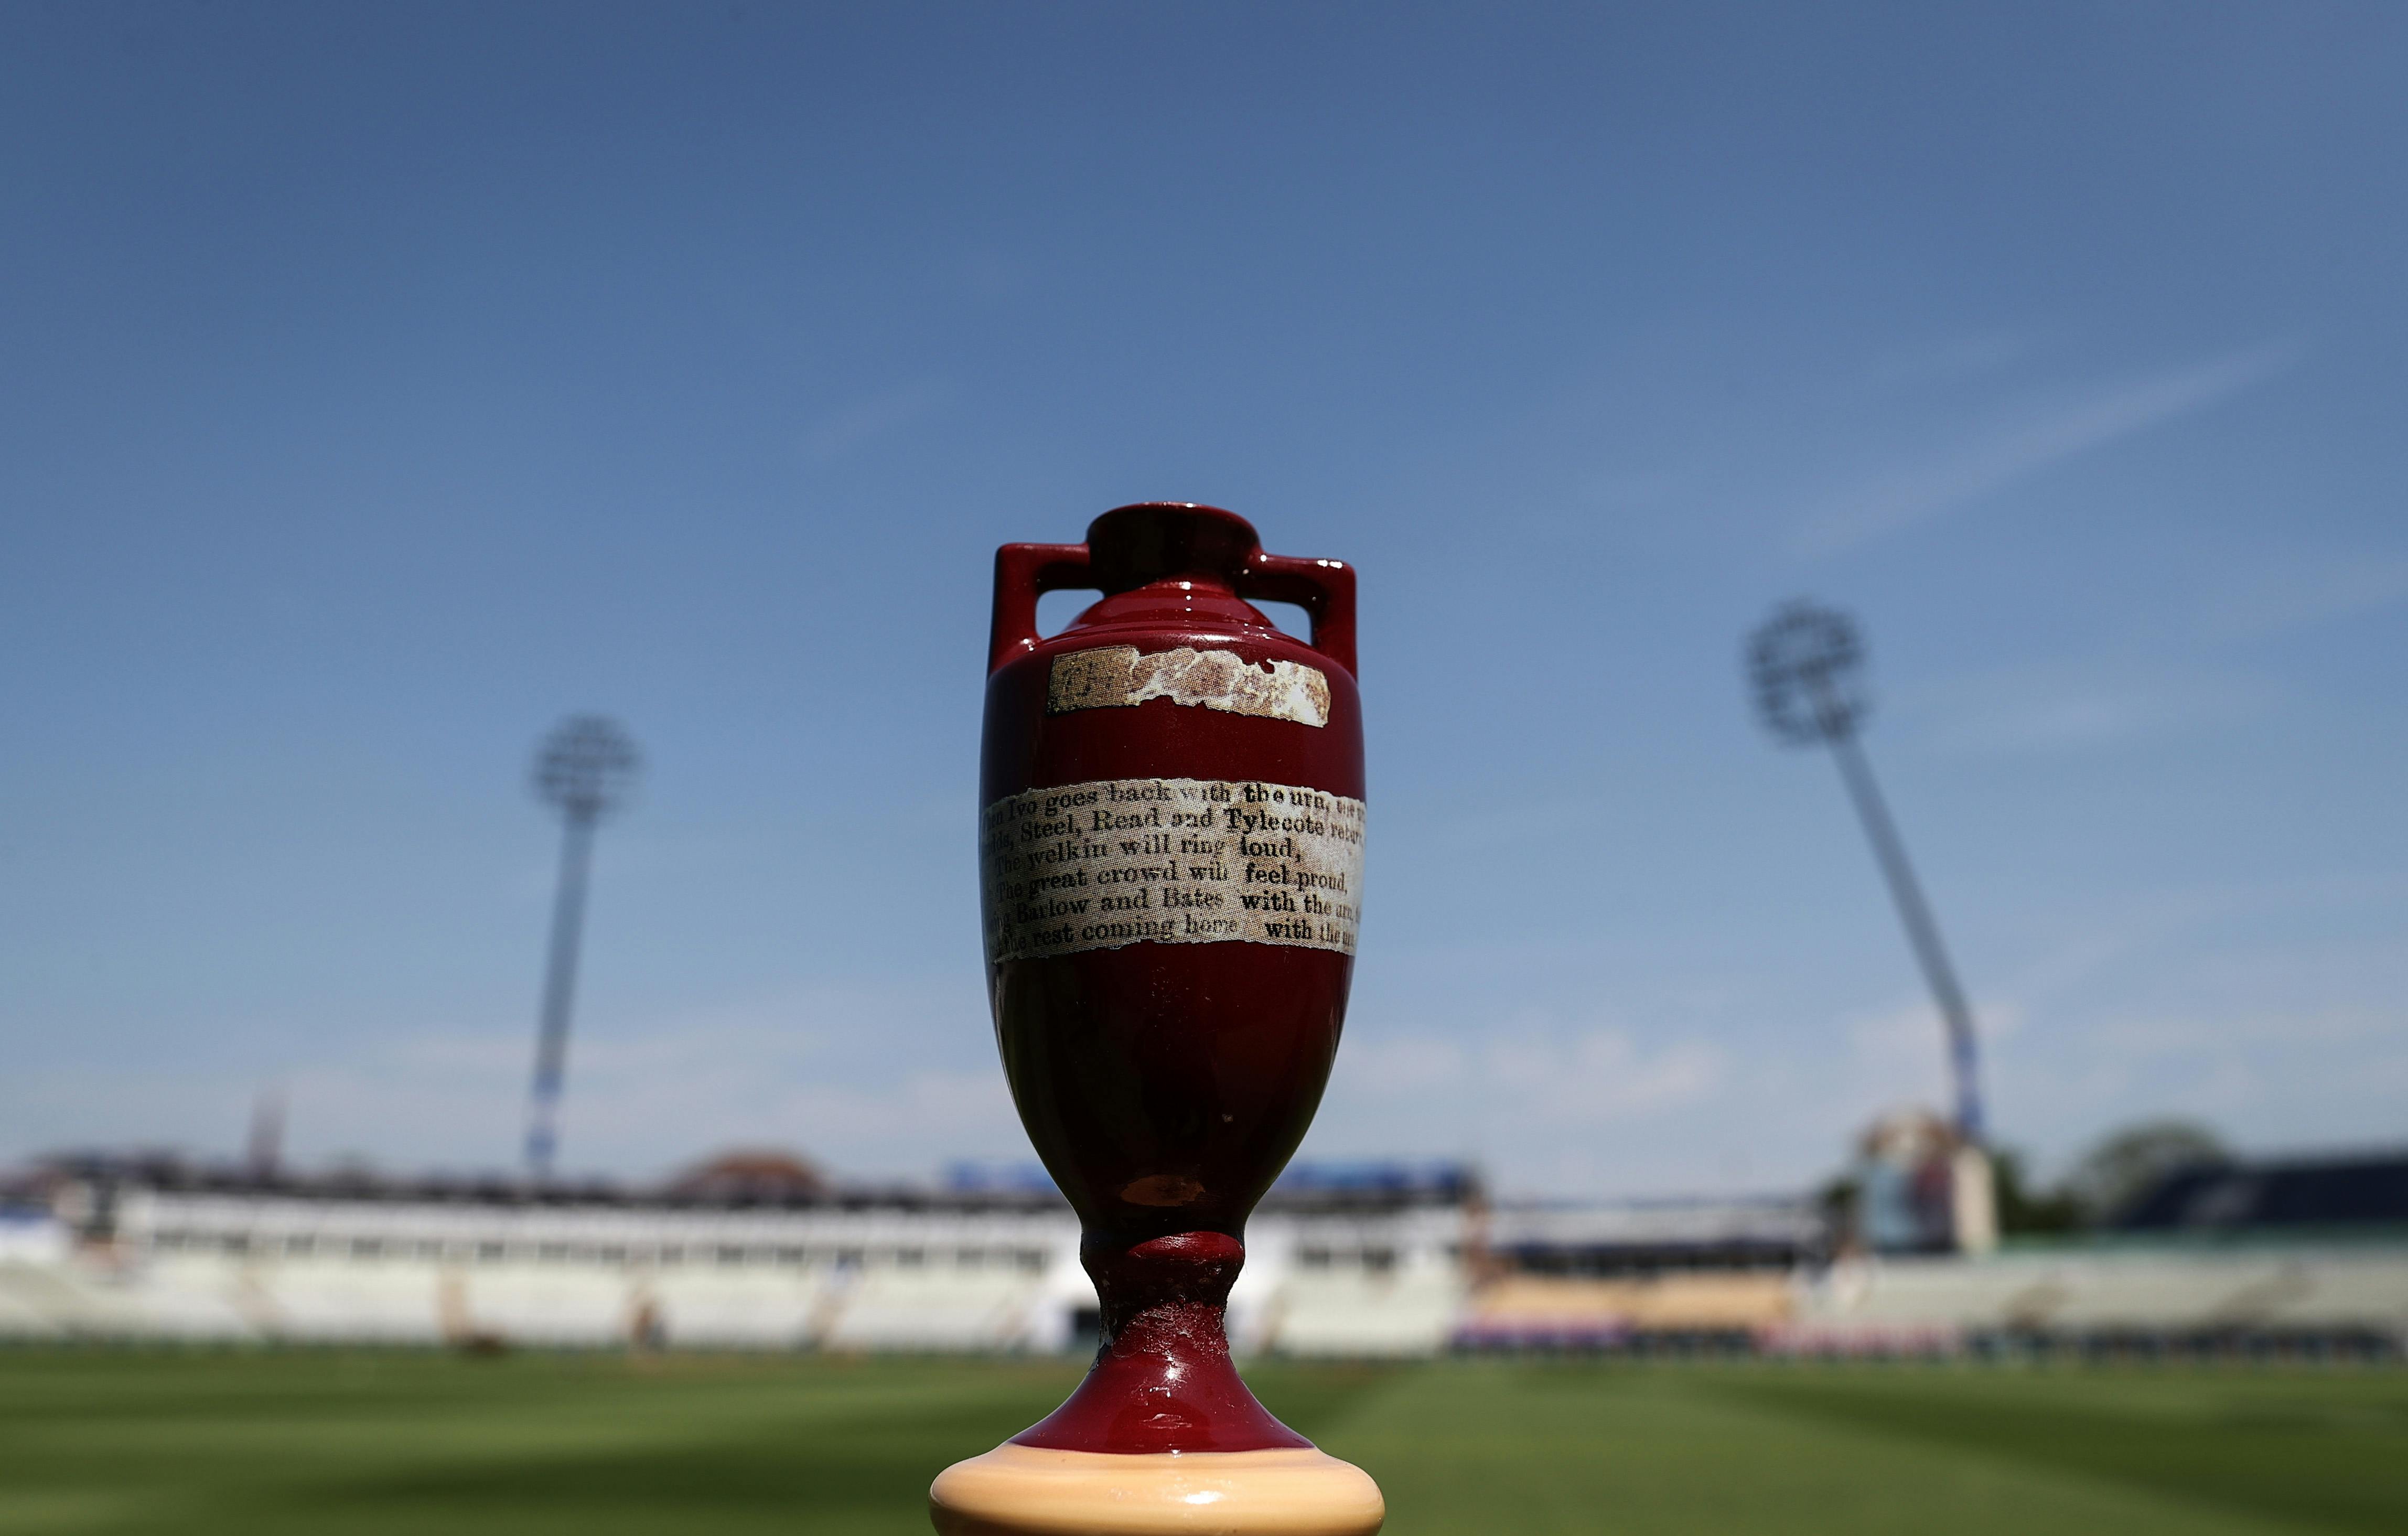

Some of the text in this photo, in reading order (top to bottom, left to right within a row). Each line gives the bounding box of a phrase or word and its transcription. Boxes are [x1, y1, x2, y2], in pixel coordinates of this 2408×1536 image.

[1007, 799, 1038, 821] Ivo
[1046, 790, 1097, 817] goes
[1106, 780, 1171, 802] back
[1243, 782, 1285, 803] the
[1021, 814, 1081, 842] Steel,
[1093, 808, 1163, 831] Read
[1171, 808, 1213, 829] and
[1223, 807, 1325, 836] Tylecote
[1028, 840, 1108, 869] welkin
[1120, 834, 1171, 855] will
[1181, 834, 1226, 857] ring
[1240, 834, 1301, 863] loud,
[1028, 869, 1087, 902] great
[1097, 860, 1178, 884] crowd
[1244, 862, 1291, 885] feel
[1296, 871, 1348, 895] proud,
[1016, 898, 1090, 925] Barlow
[1101, 888, 1149, 911] and
[1240, 890, 1296, 912] with
[1304, 893, 1332, 917] the
[1033, 921, 1075, 947] rest
[1081, 915, 1174, 941] coming
[1264, 918, 1313, 940] with
